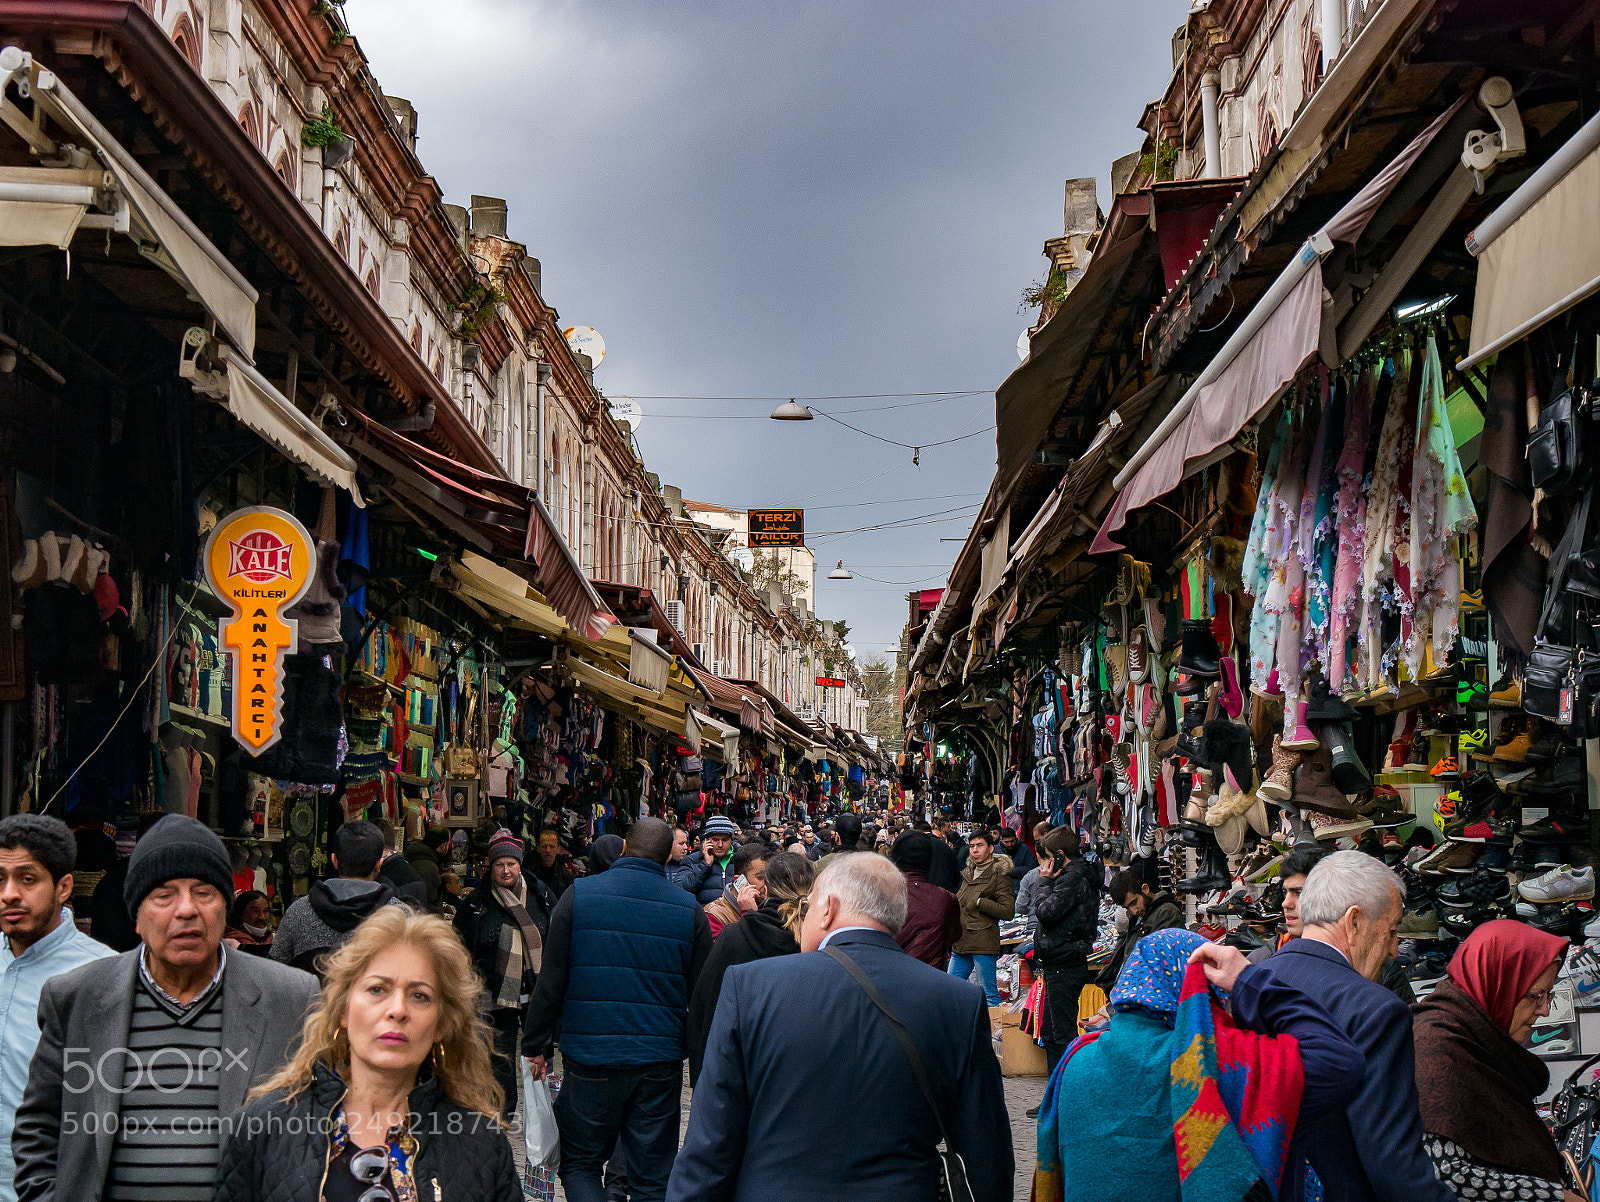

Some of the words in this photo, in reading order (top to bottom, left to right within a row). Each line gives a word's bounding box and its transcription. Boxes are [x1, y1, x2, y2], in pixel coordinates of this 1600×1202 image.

[231, 544, 290, 576] KALE
[233, 588, 287, 598] KİLİTLERİ
[250, 608, 268, 739] ANAHTARCI
[816, 676, 834, 687] WC
